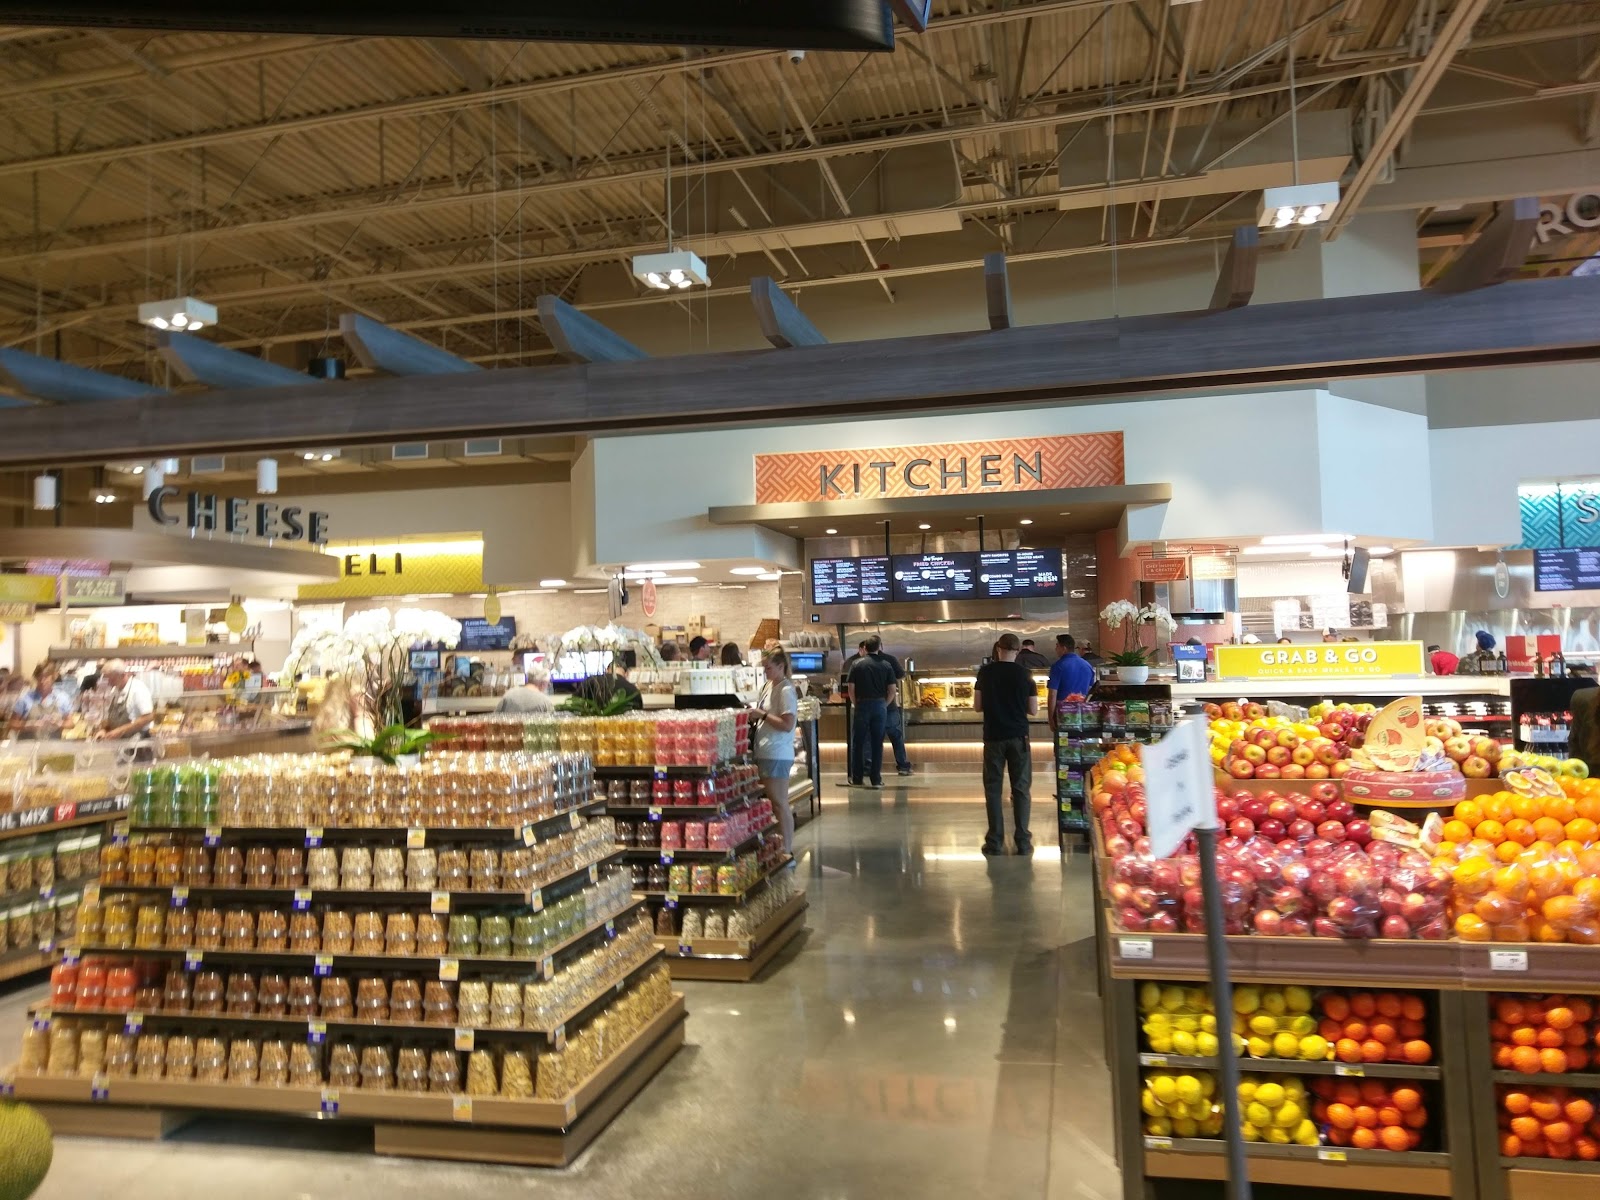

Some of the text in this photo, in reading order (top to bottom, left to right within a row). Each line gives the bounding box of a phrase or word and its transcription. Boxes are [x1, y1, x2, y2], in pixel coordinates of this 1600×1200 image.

[820, 451, 1043, 496] KITCHEN
[147, 485, 329, 545] CHEESE
[1260, 648, 1378, 665] GRAB & GO
[20, 807, 50, 827] MIX
